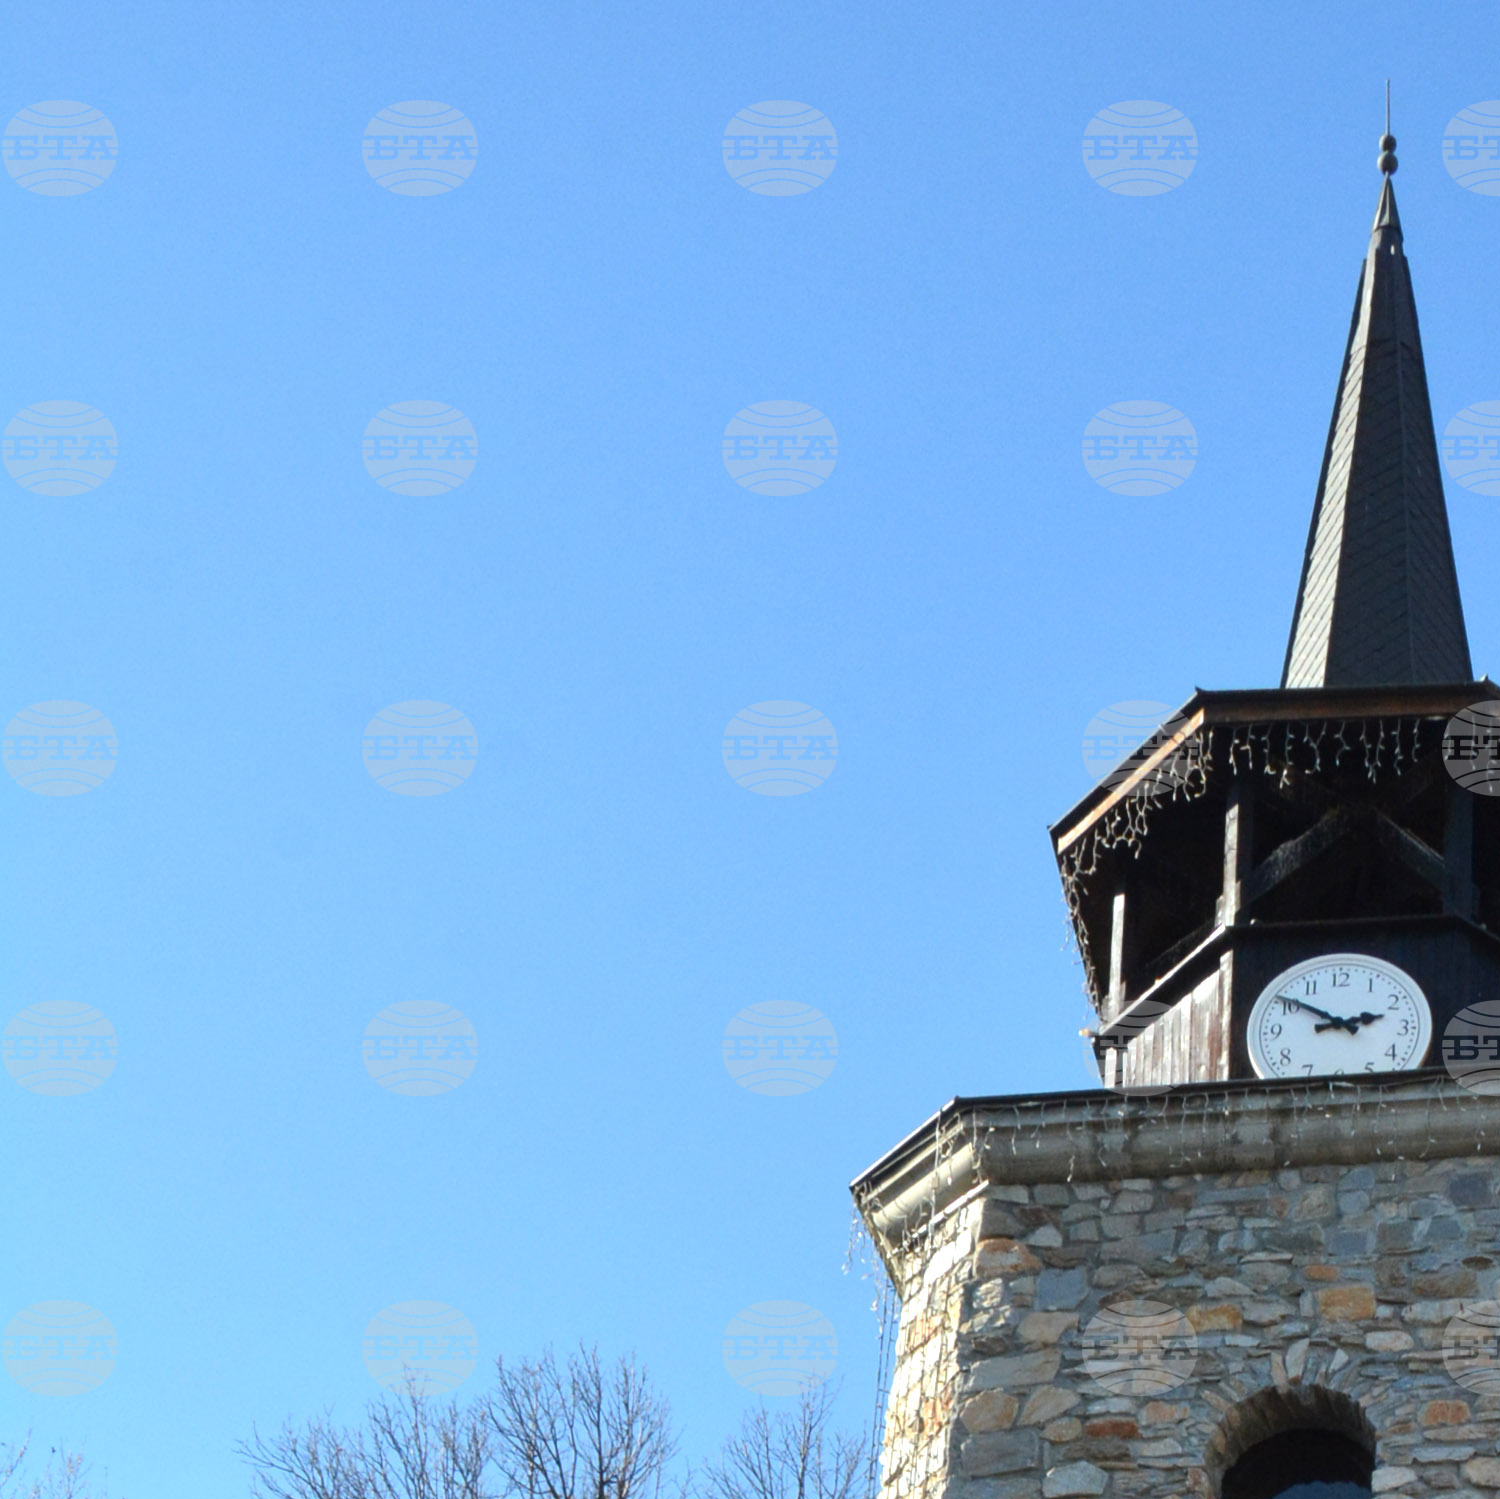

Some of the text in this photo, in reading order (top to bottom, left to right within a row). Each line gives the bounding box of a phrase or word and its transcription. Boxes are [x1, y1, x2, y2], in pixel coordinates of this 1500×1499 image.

[1305, 979, 1318, 996] 11
[1331, 972, 1351, 988] 12
[1282, 1000, 1300, 1016] 10
[1388, 994, 1400, 1010] 2
[1270, 1023, 1282, 1041] 9
[1397, 1020, 1409, 1036] 3
[1280, 1047, 1292, 1066] 8
[1384, 1043, 1397, 1061] 4
